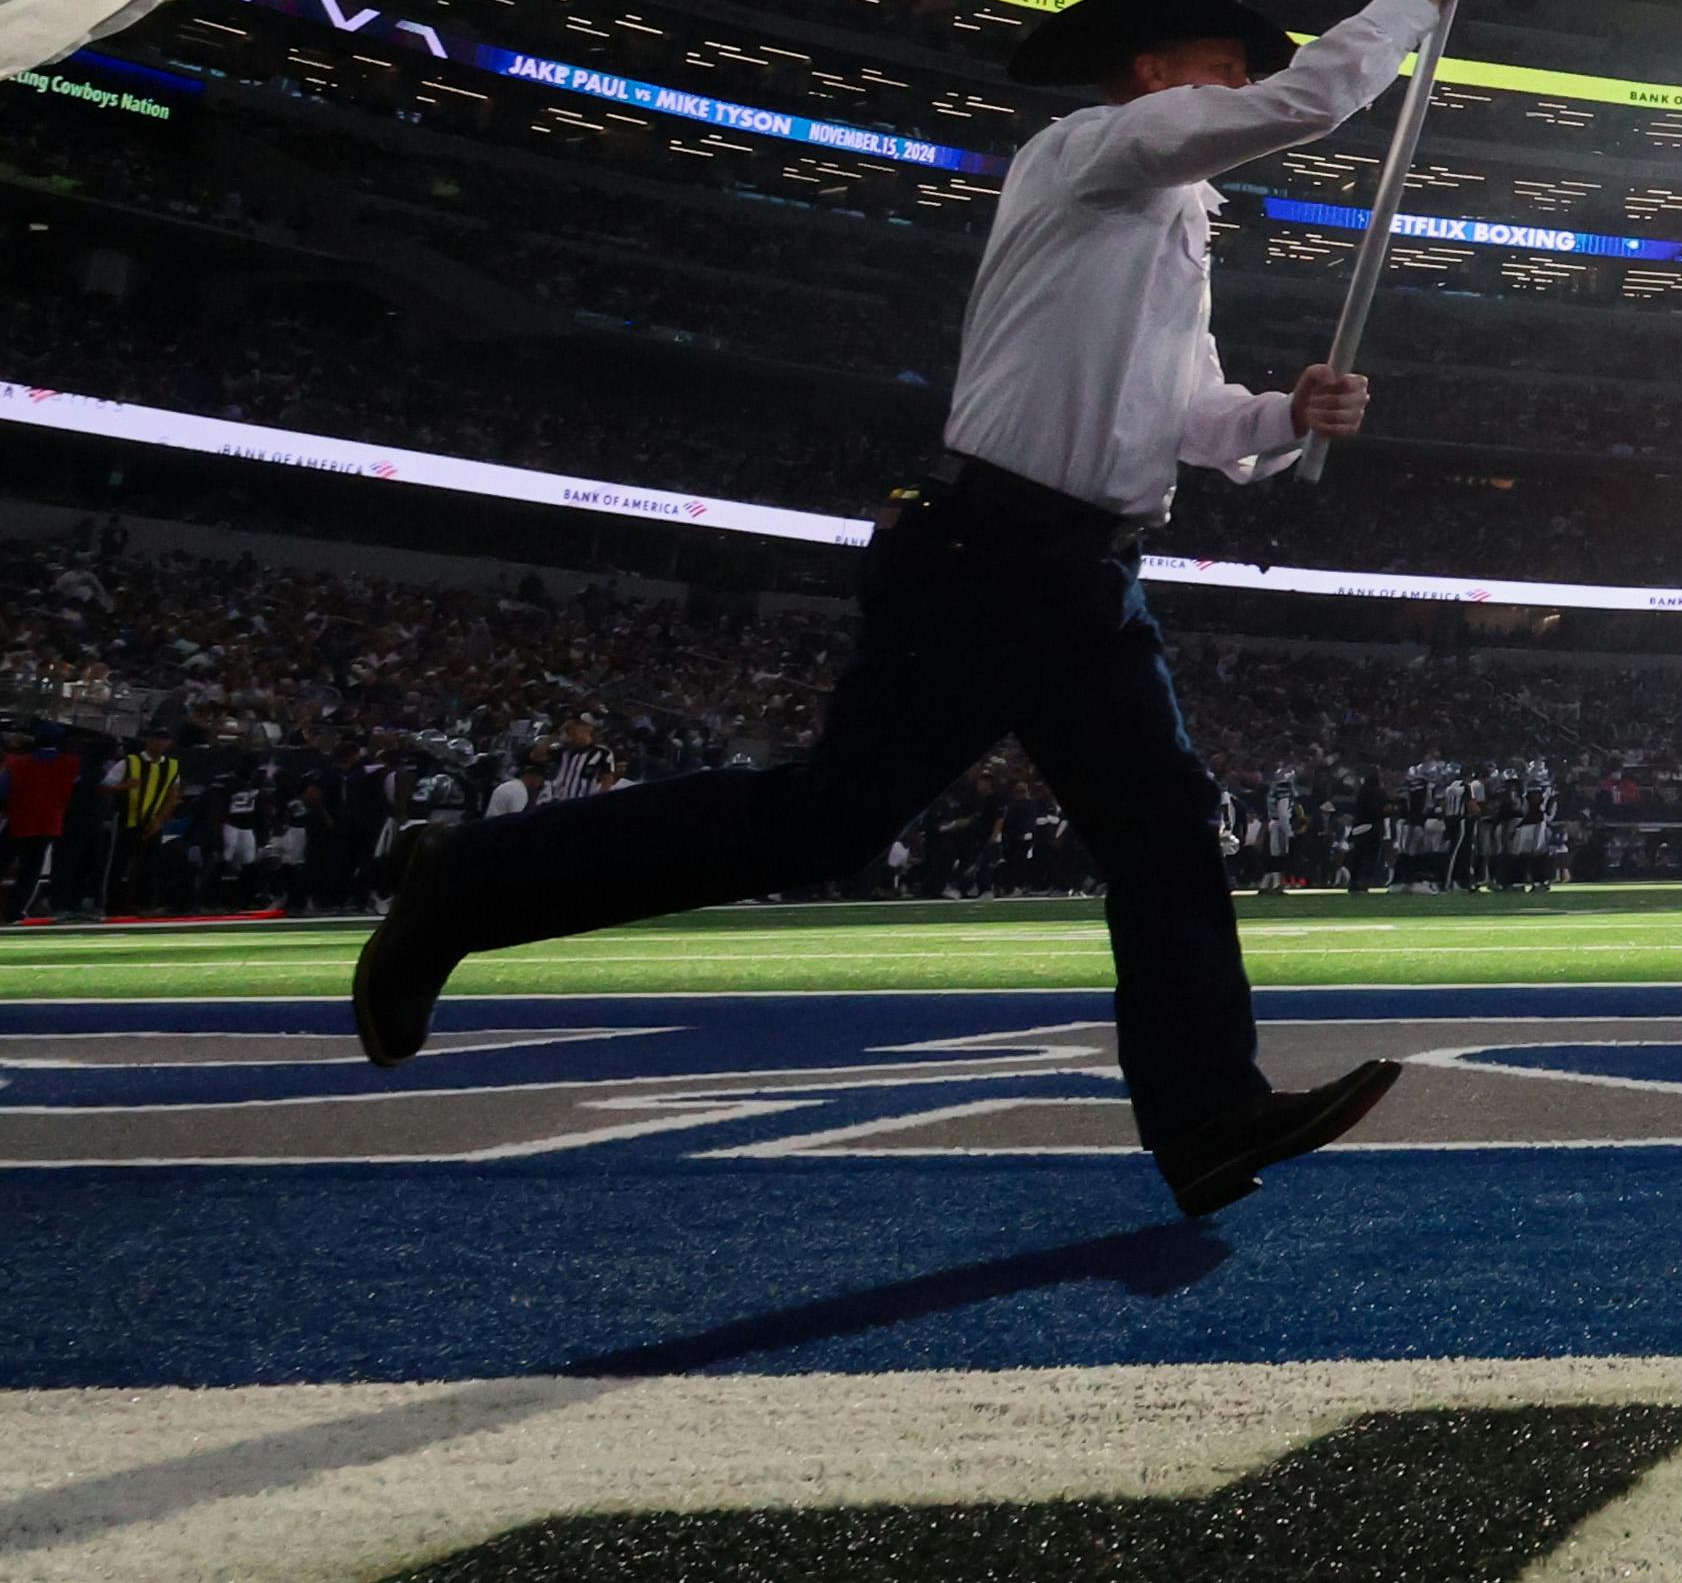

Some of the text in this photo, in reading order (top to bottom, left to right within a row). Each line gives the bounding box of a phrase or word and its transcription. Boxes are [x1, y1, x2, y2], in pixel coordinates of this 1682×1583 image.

[51, 75, 170, 119] Cowboys Nation
[509, 55, 570, 86] JAKE
[572, 67, 629, 101] PAUL
[634, 87, 652, 103] vs
[656, 89, 711, 121] MIKE
[715, 102, 792, 136] TYSON
[903, 141, 936, 164] 2024
[1629, 90, 1671, 106] BANK
[1472, 221, 1577, 253] BOXING
[563, 488, 681, 516] BANK OF AMERICA
